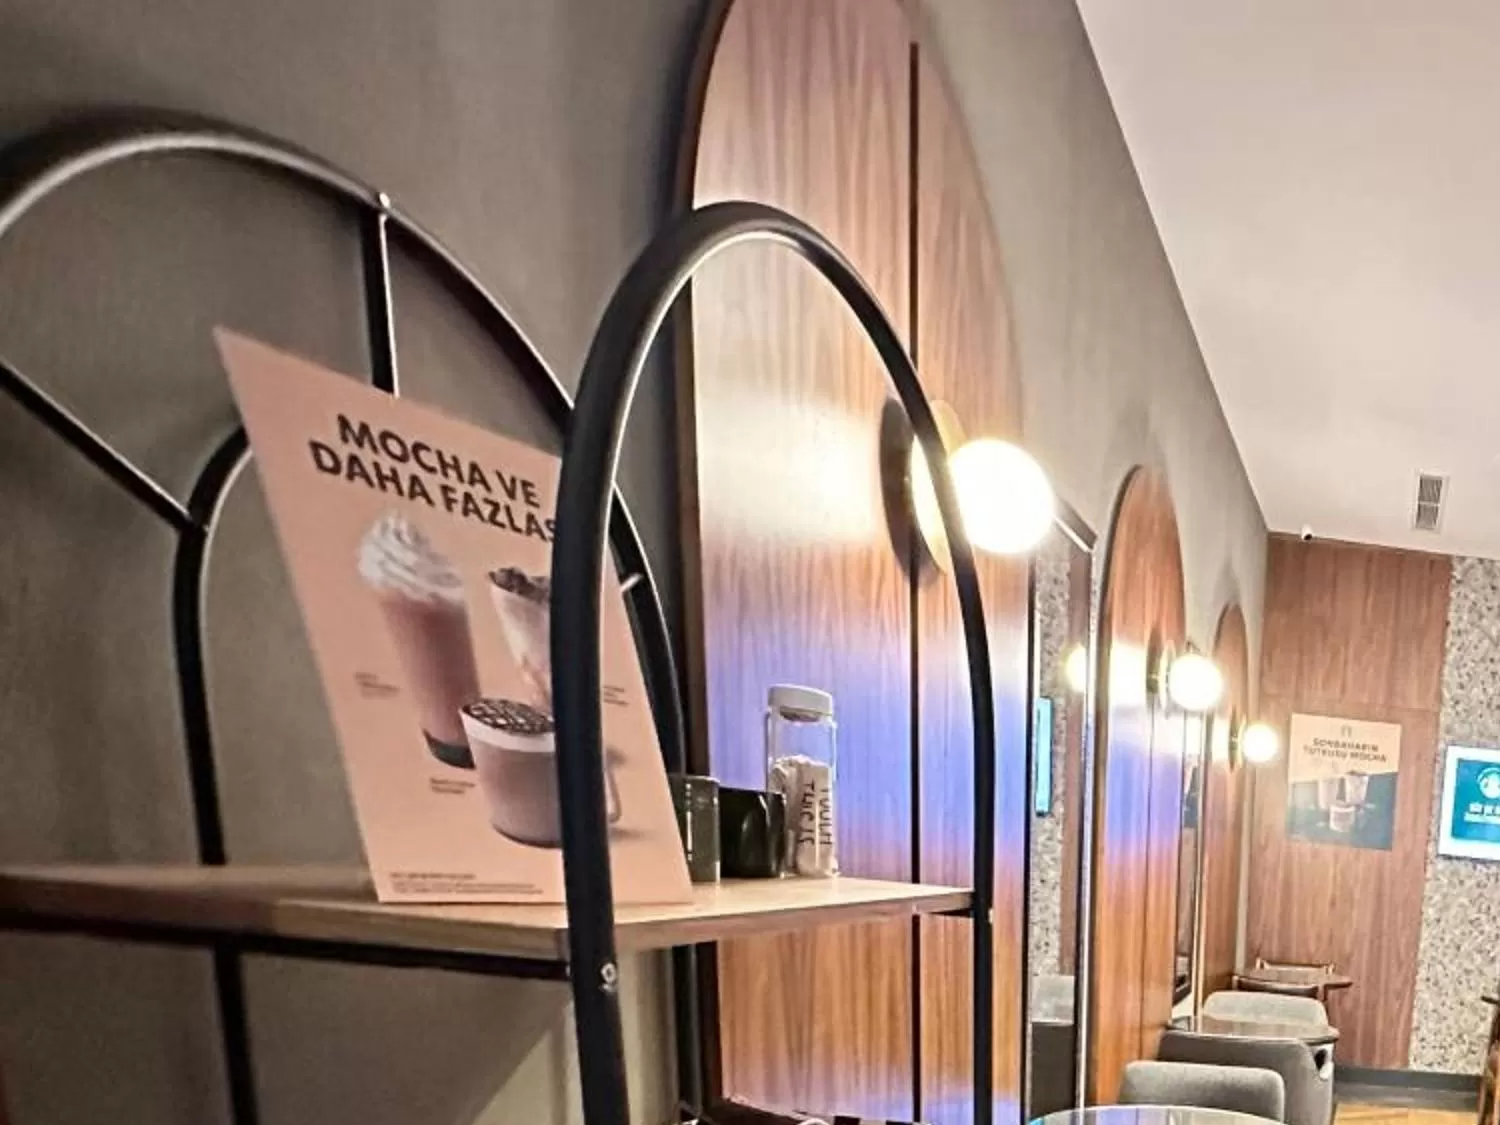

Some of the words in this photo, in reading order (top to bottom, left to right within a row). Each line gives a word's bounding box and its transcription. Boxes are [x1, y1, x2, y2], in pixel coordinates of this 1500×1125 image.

[308, 439, 435, 508] DAHA
[440, 483, 557, 543] FAZLAS
[337, 413, 493, 493] MOCHA
[496, 469, 541, 509] VE
